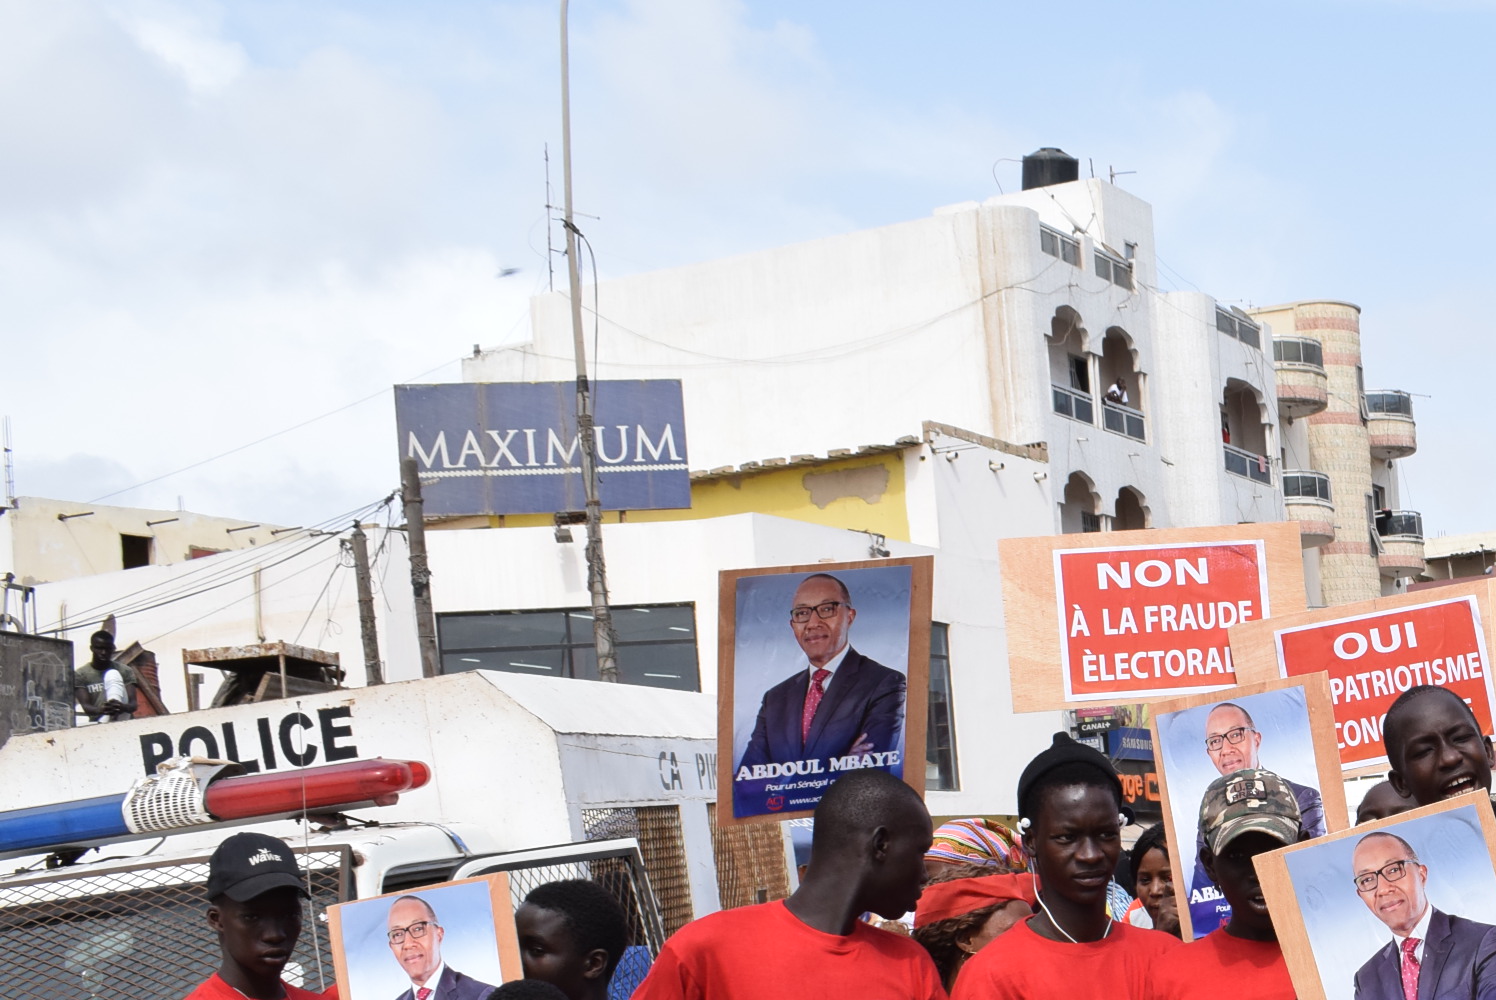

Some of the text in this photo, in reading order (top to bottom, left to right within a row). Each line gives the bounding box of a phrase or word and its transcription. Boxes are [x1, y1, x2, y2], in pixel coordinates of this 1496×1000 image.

[408, 423, 683, 468] MAXIMUM
[1096, 557, 1209, 590] NON
[1070, 600, 1253, 638] À LA FRAUDE
[1333, 621, 1418, 660] OUI
[1082, 646, 1235, 683] ÈLECTORAL
[1329, 651, 1483, 705] PATRIOTISME
[139, 705, 359, 777] POLICE
[1081, 721, 1111, 731] CANAL+
[1122, 737, 1152, 751] SAMSUNG
[735, 750, 901, 782] ABDOUL MBAYE
[797, 778, 828, 791] Sénégal
[1119, 773, 1144, 803] nge
